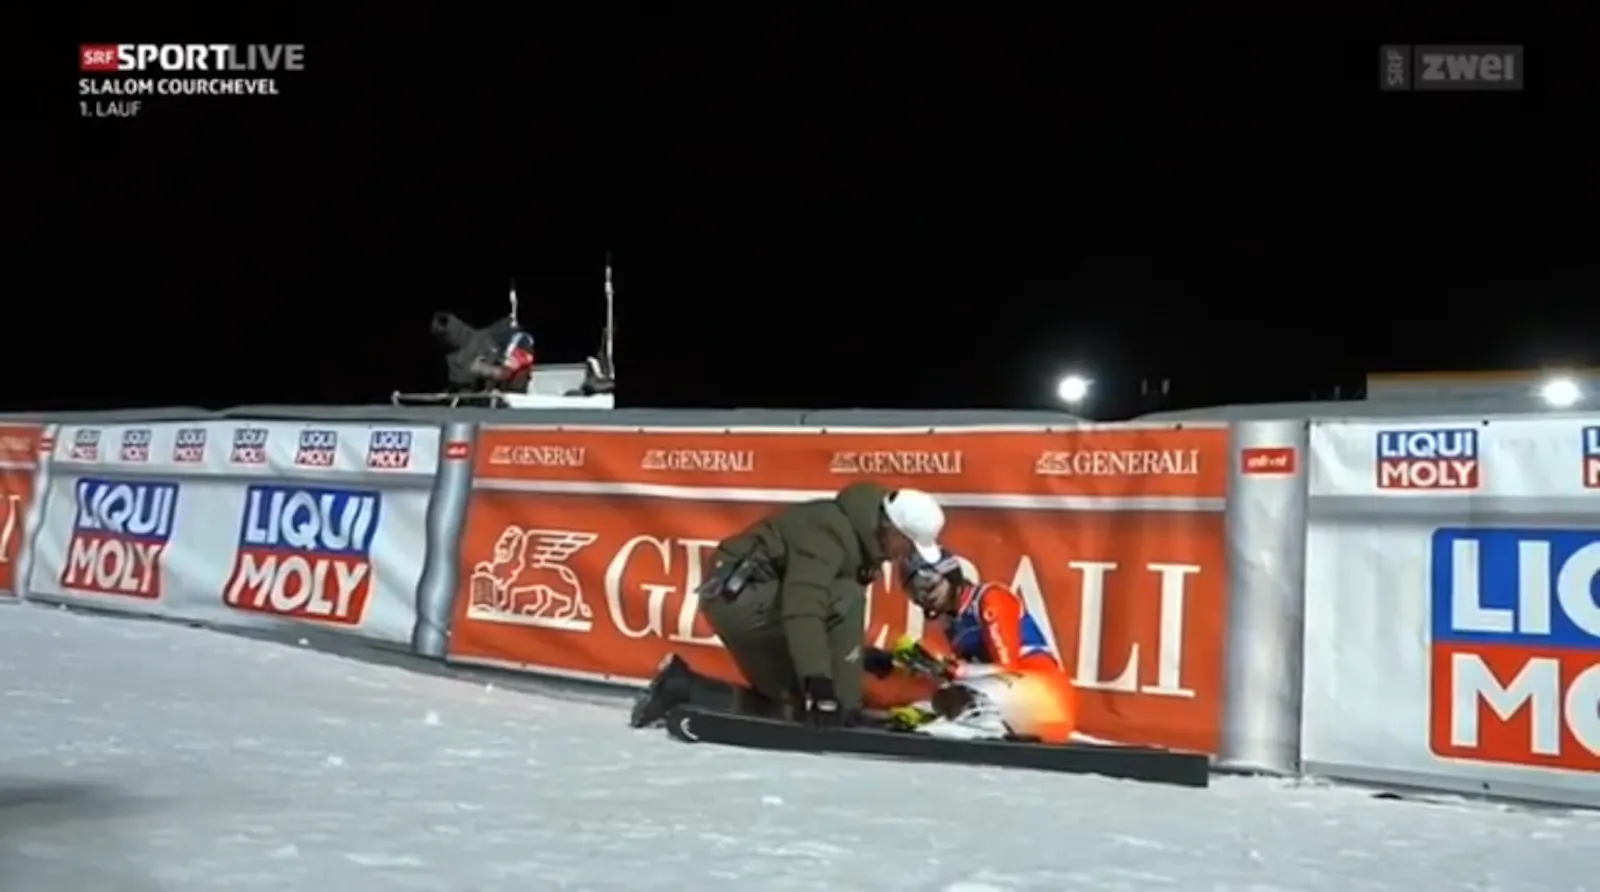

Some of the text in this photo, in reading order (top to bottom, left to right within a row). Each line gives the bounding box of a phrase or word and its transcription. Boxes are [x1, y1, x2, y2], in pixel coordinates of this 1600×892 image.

[511, 447, 585, 466] GENERALI
[1382, 432, 1473, 457] LIQUI
[667, 450, 754, 471] GENERALI
[859, 451, 962, 474] GENERALI
[1073, 450, 1199, 475] GENERALI
[1382, 461, 1475, 486] MOLY
[79, 482, 174, 535] LIQUI
[246, 490, 375, 550] LIQUI
[65, 536, 162, 593] MOLY
[228, 553, 369, 617] MOLY
[604, 534, 1201, 698] GEALI
